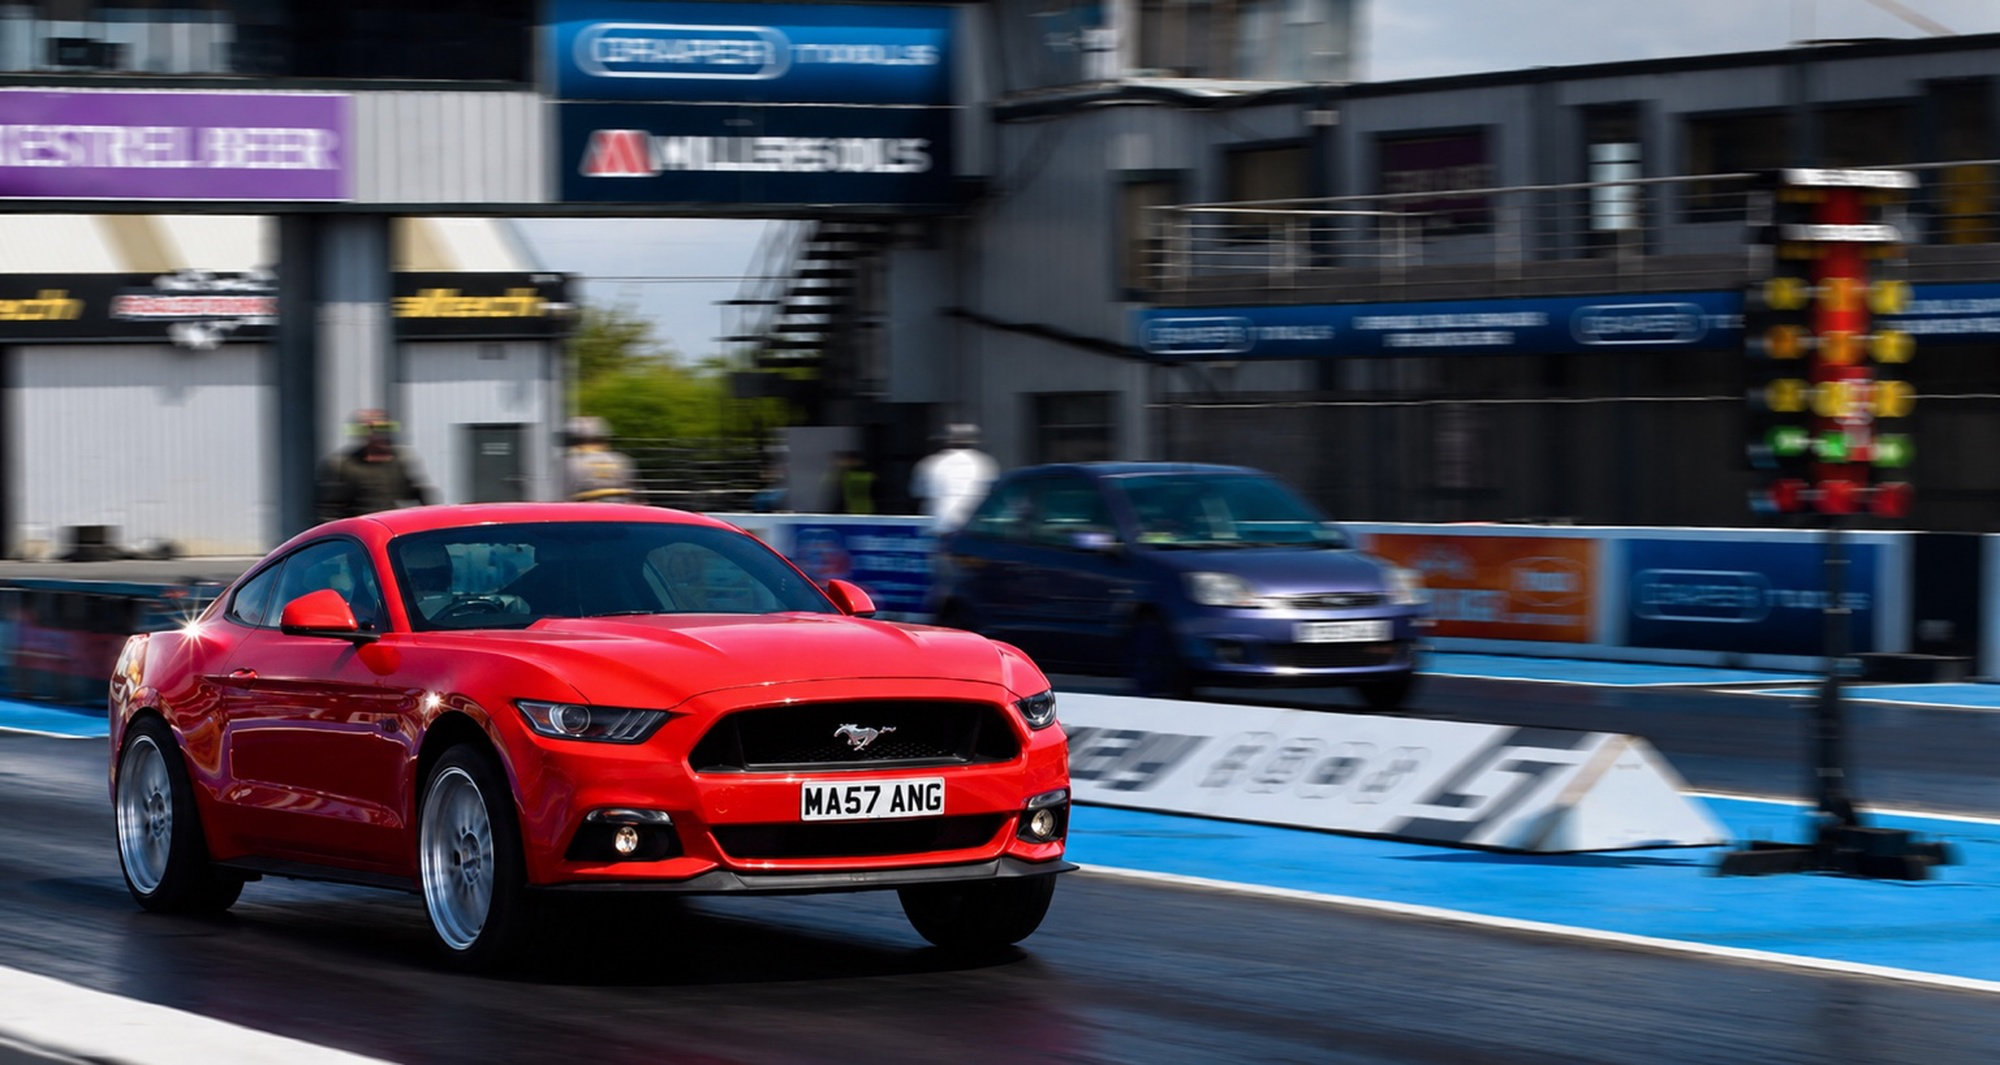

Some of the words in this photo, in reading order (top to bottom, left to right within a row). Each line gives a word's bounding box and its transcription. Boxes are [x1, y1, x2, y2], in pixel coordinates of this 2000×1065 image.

[207, 126, 340, 170] BEER
[804, 785, 881, 816] MA57
[890, 783, 942, 812] ANG
